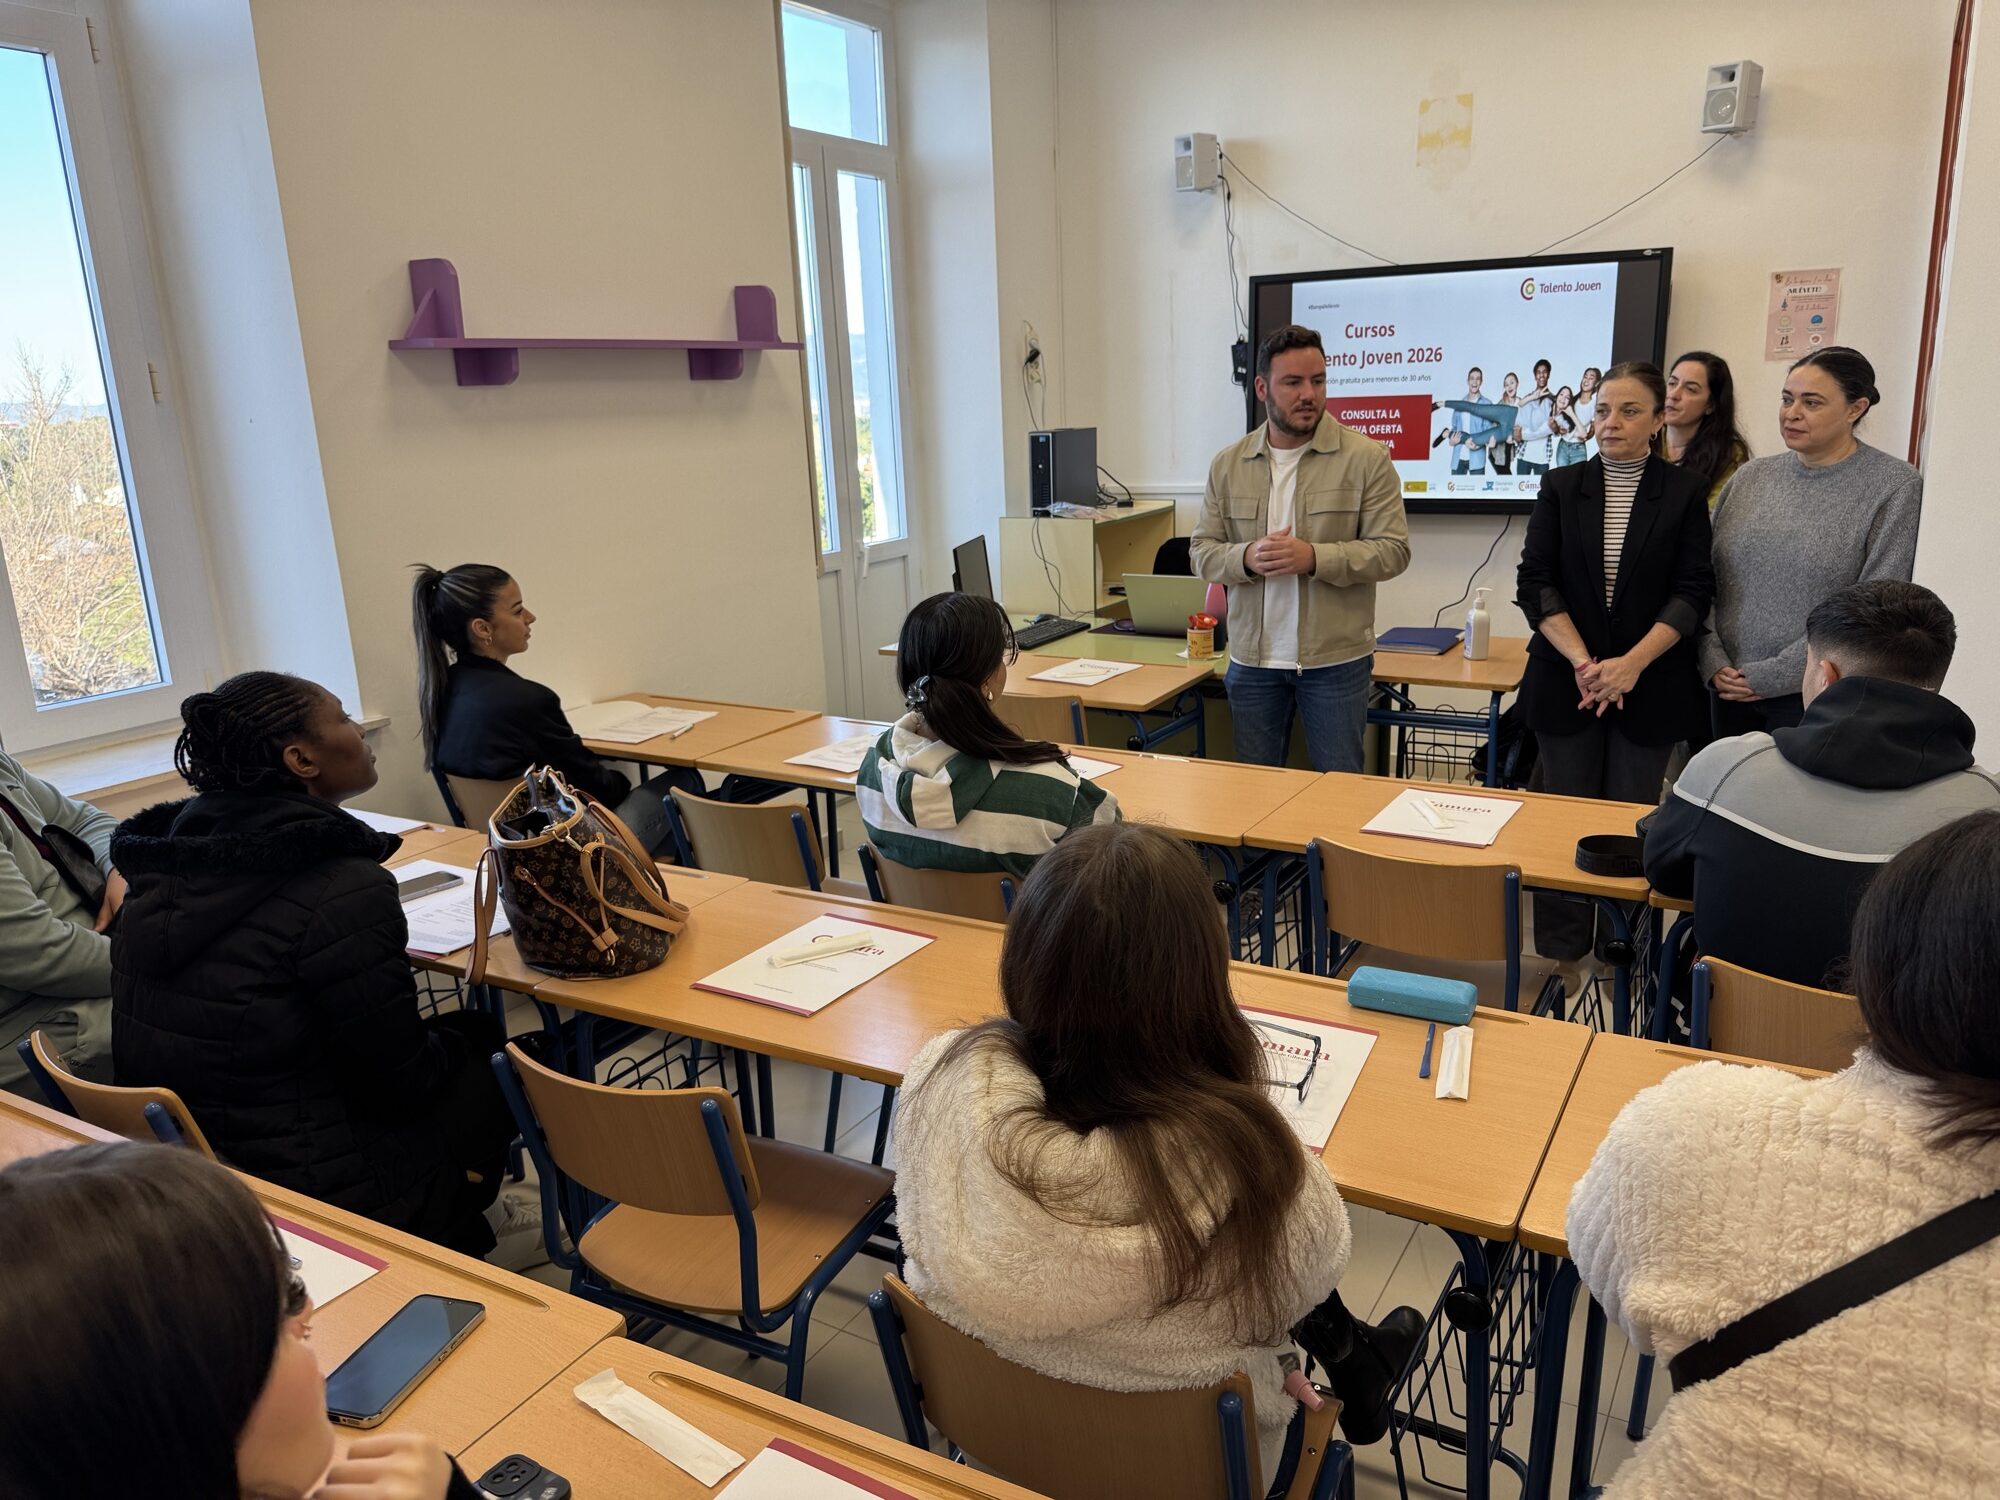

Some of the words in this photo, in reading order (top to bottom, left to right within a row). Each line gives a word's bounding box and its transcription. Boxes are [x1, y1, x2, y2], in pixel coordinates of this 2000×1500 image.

[1540, 282, 1573, 294] Talento
[1345, 323, 1395, 339] Cursos
[1324, 352, 1357, 367] ento
[1359, 350, 1402, 369] Joven
[1407, 347, 1443, 363] 2026
[1340, 376, 1361, 386] gratuita
[1361, 377, 1374, 385] para
[1418, 374, 1431, 382] años
[1340, 409, 1388, 420] CONSULTA
[1389, 409, 1401, 419] LA
[1369, 423, 1403, 435] OFERTA
[1262, 1041, 1330, 1061] mara
